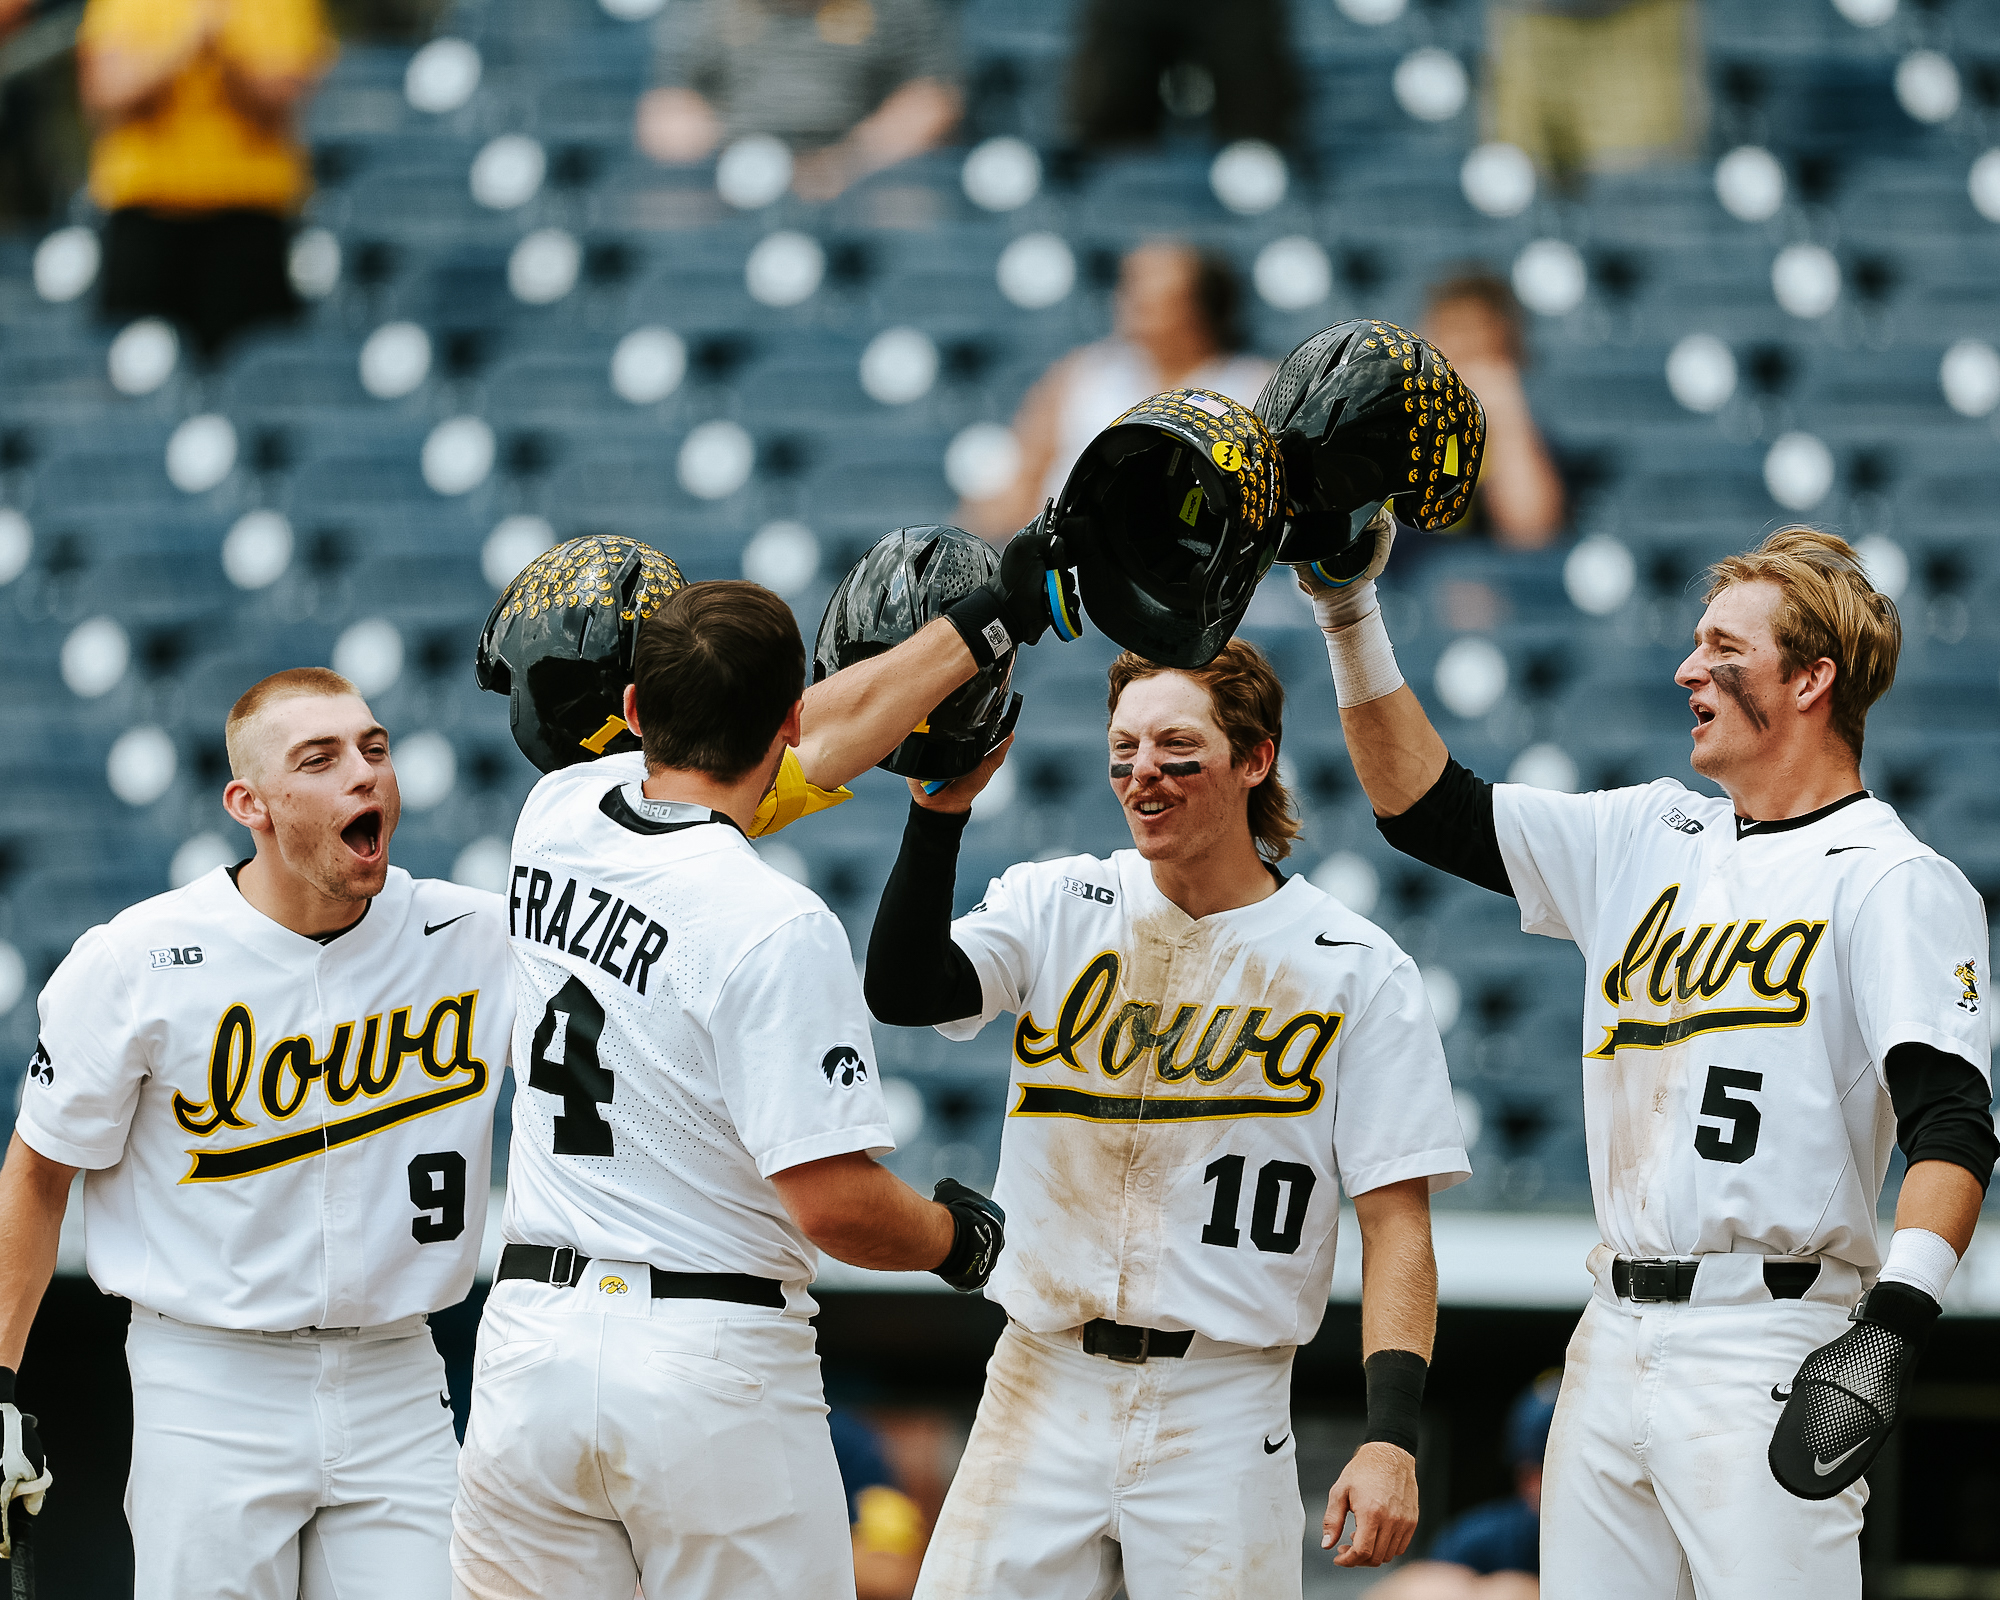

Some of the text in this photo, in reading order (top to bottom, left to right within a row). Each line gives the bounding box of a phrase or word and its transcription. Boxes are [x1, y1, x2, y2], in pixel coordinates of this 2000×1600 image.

[641, 803, 672, 819] PRO
[509, 865, 669, 996] FRAZIER
[1601, 883, 1829, 1009] Iowa
[171, 988, 488, 1138] Iowa
[528, 973, 615, 1157] 4
[1012, 949, 1345, 1091] Iowa
[1693, 1064, 1764, 1165] 5
[407, 1150, 467, 1245] 9
[1200, 1153, 1317, 1255] 10
